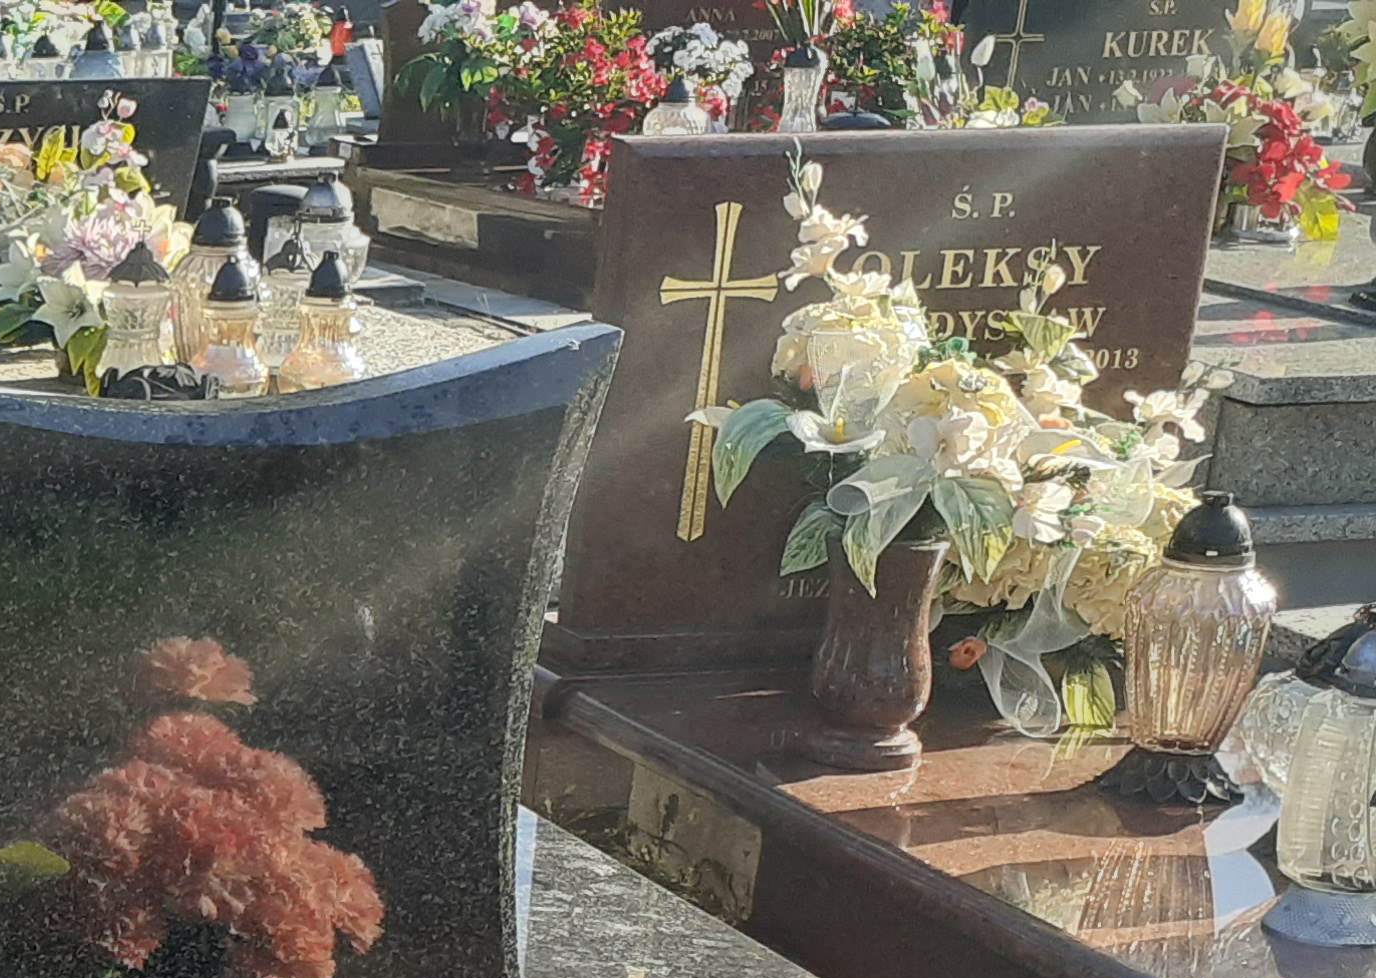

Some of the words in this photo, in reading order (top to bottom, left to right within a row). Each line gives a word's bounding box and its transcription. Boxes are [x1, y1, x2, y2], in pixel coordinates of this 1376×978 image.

[687, 8, 736, 22] ANNA
[1102, 28, 1216, 58] KUREK
[1046, 66, 1092, 87] JAN
